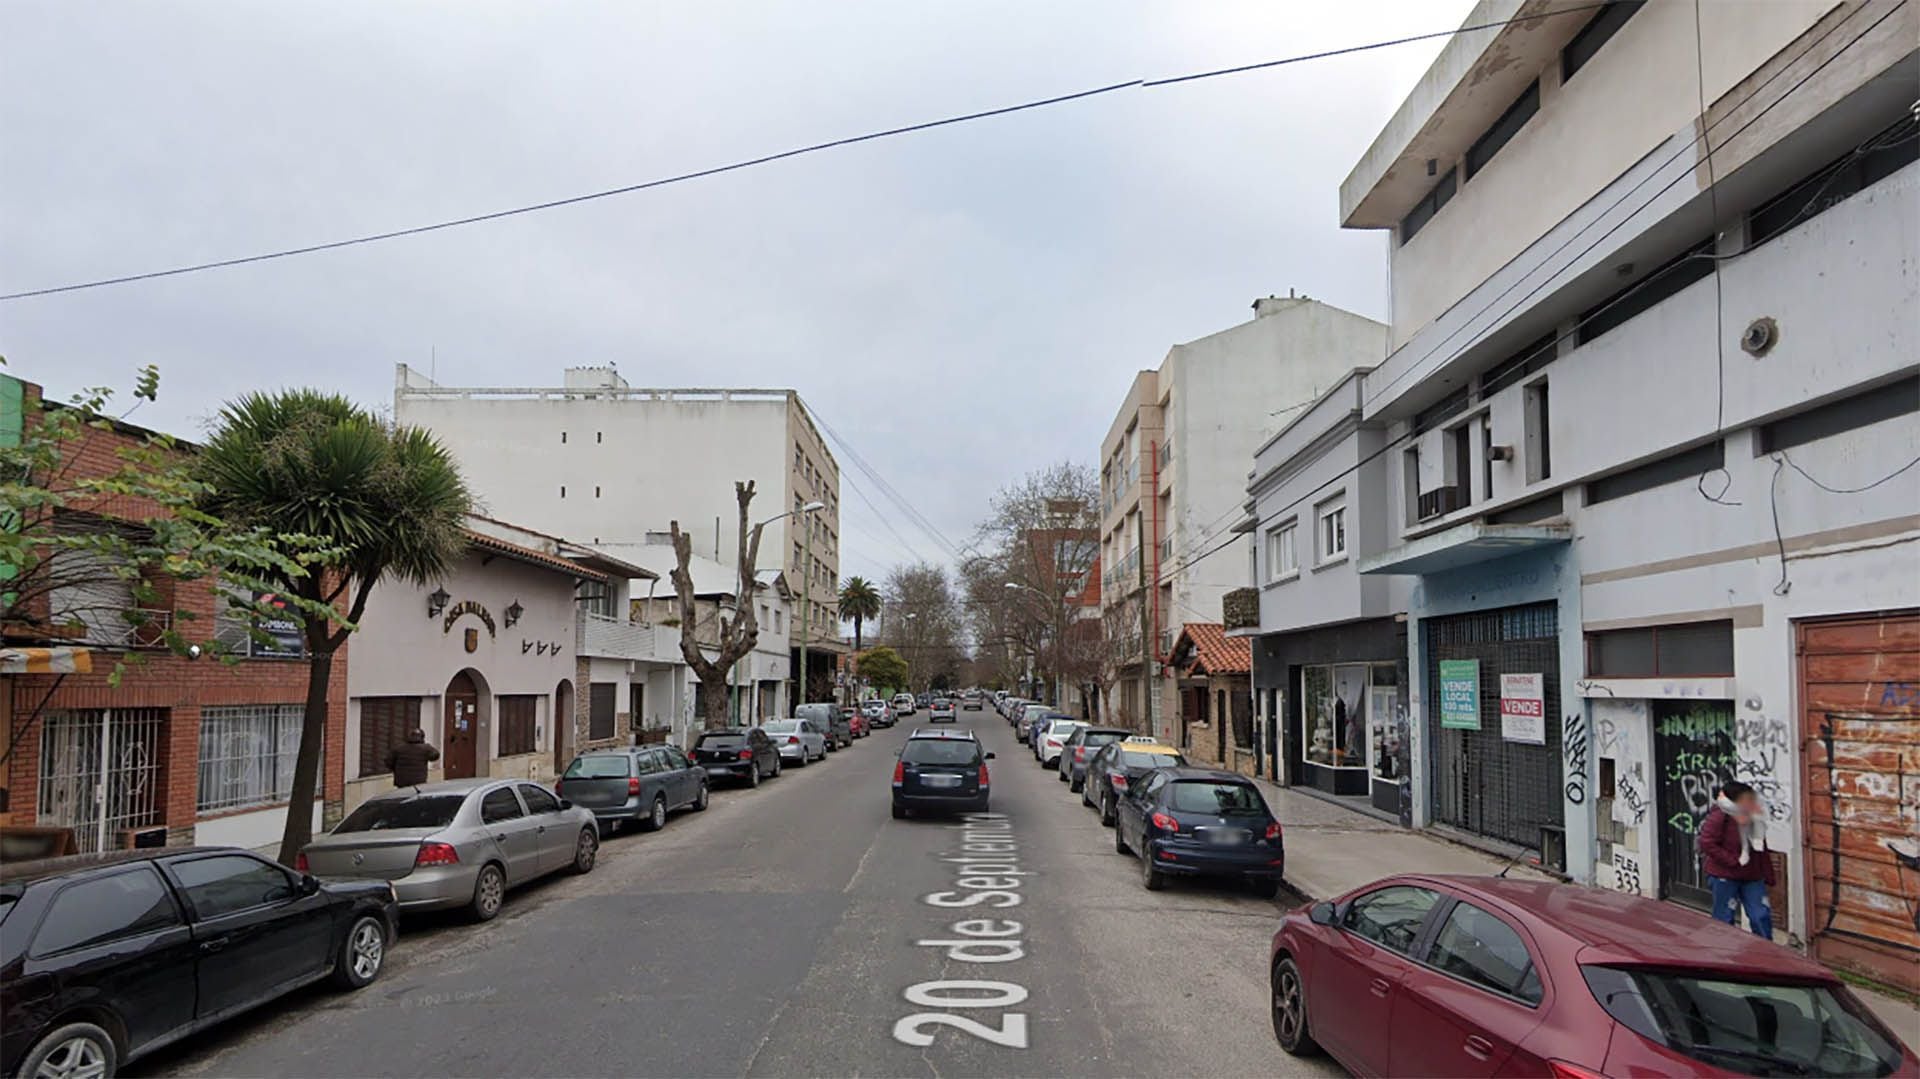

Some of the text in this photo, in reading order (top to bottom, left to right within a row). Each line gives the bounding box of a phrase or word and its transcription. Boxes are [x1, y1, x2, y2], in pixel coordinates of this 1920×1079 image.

[1442, 681, 1474, 691] VENDE
[1446, 691, 1472, 702] LOCAL
[1503, 701, 1540, 714] VENDE
[1614, 853, 1640, 875] FLEA
[1615, 869, 1642, 896] 333
